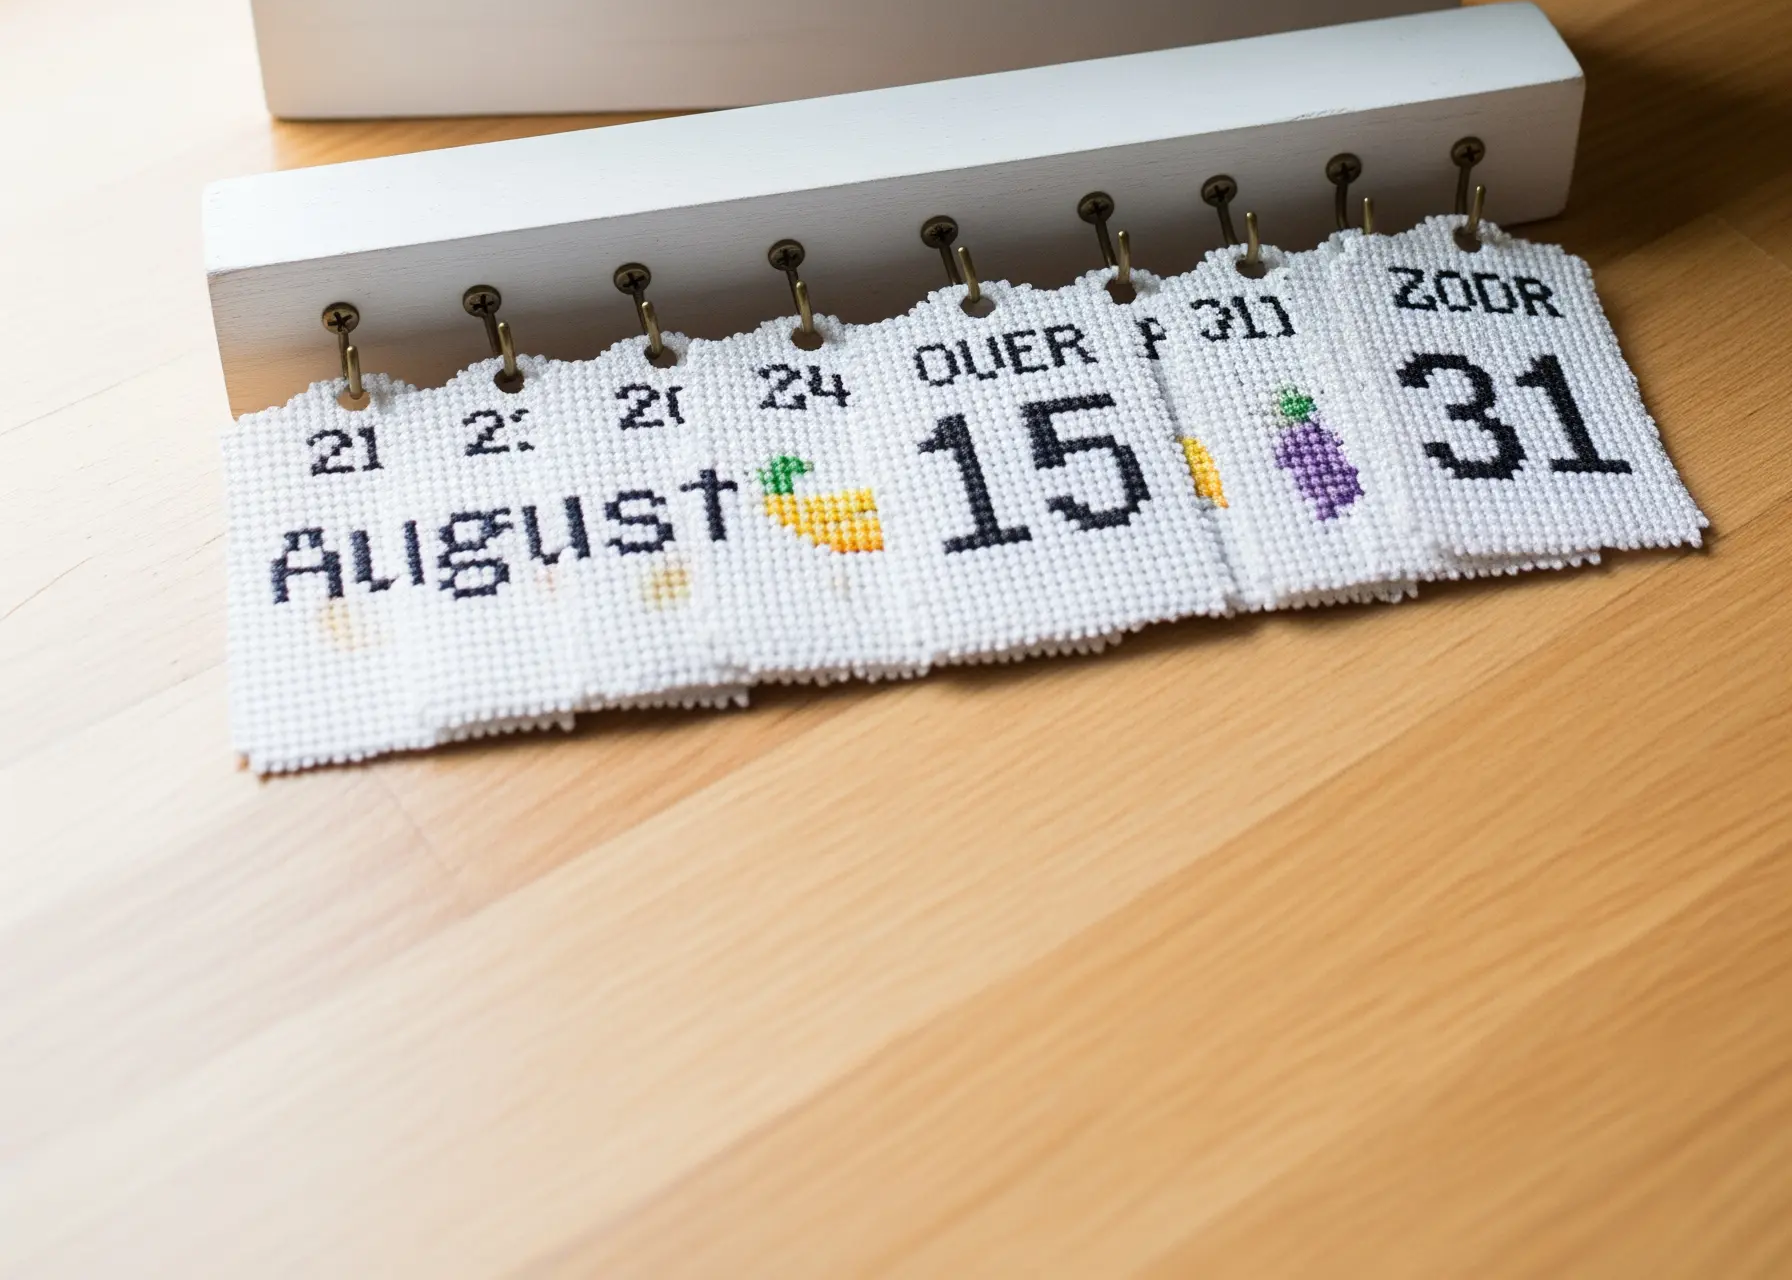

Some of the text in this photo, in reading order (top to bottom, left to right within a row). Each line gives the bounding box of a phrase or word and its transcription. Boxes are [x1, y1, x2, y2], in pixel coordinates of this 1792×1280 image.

[308, 426, 383, 476] 21
[758, 364, 851, 410] 24
[1396, 353, 1633, 481] 31
[270, 468, 738, 604] August
[918, 393, 1151, 554] 15
